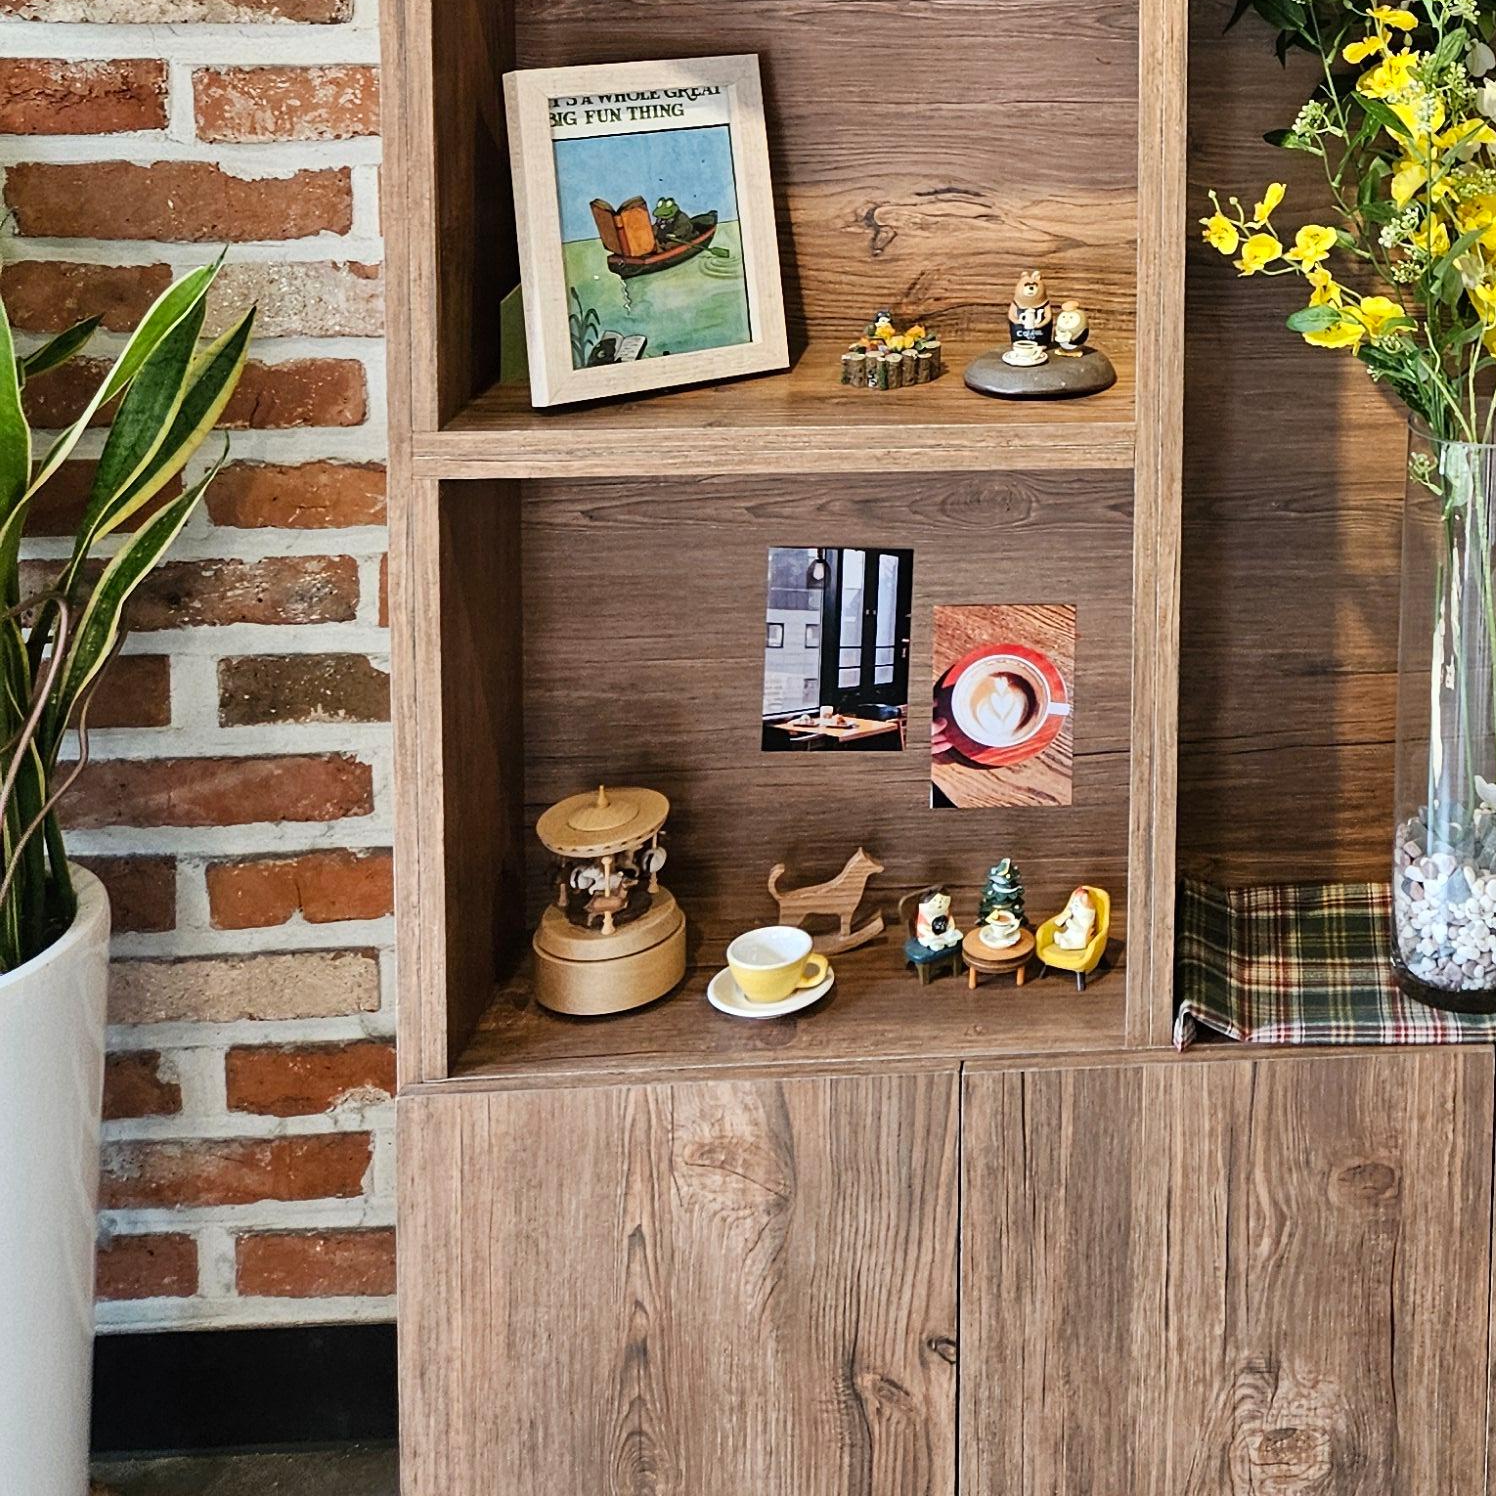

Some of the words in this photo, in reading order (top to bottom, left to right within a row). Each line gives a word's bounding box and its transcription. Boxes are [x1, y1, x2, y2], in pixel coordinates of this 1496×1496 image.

[549, 111, 577, 128] BIG
[585, 108, 622, 124] FUN
[627, 104, 684, 121] THING
